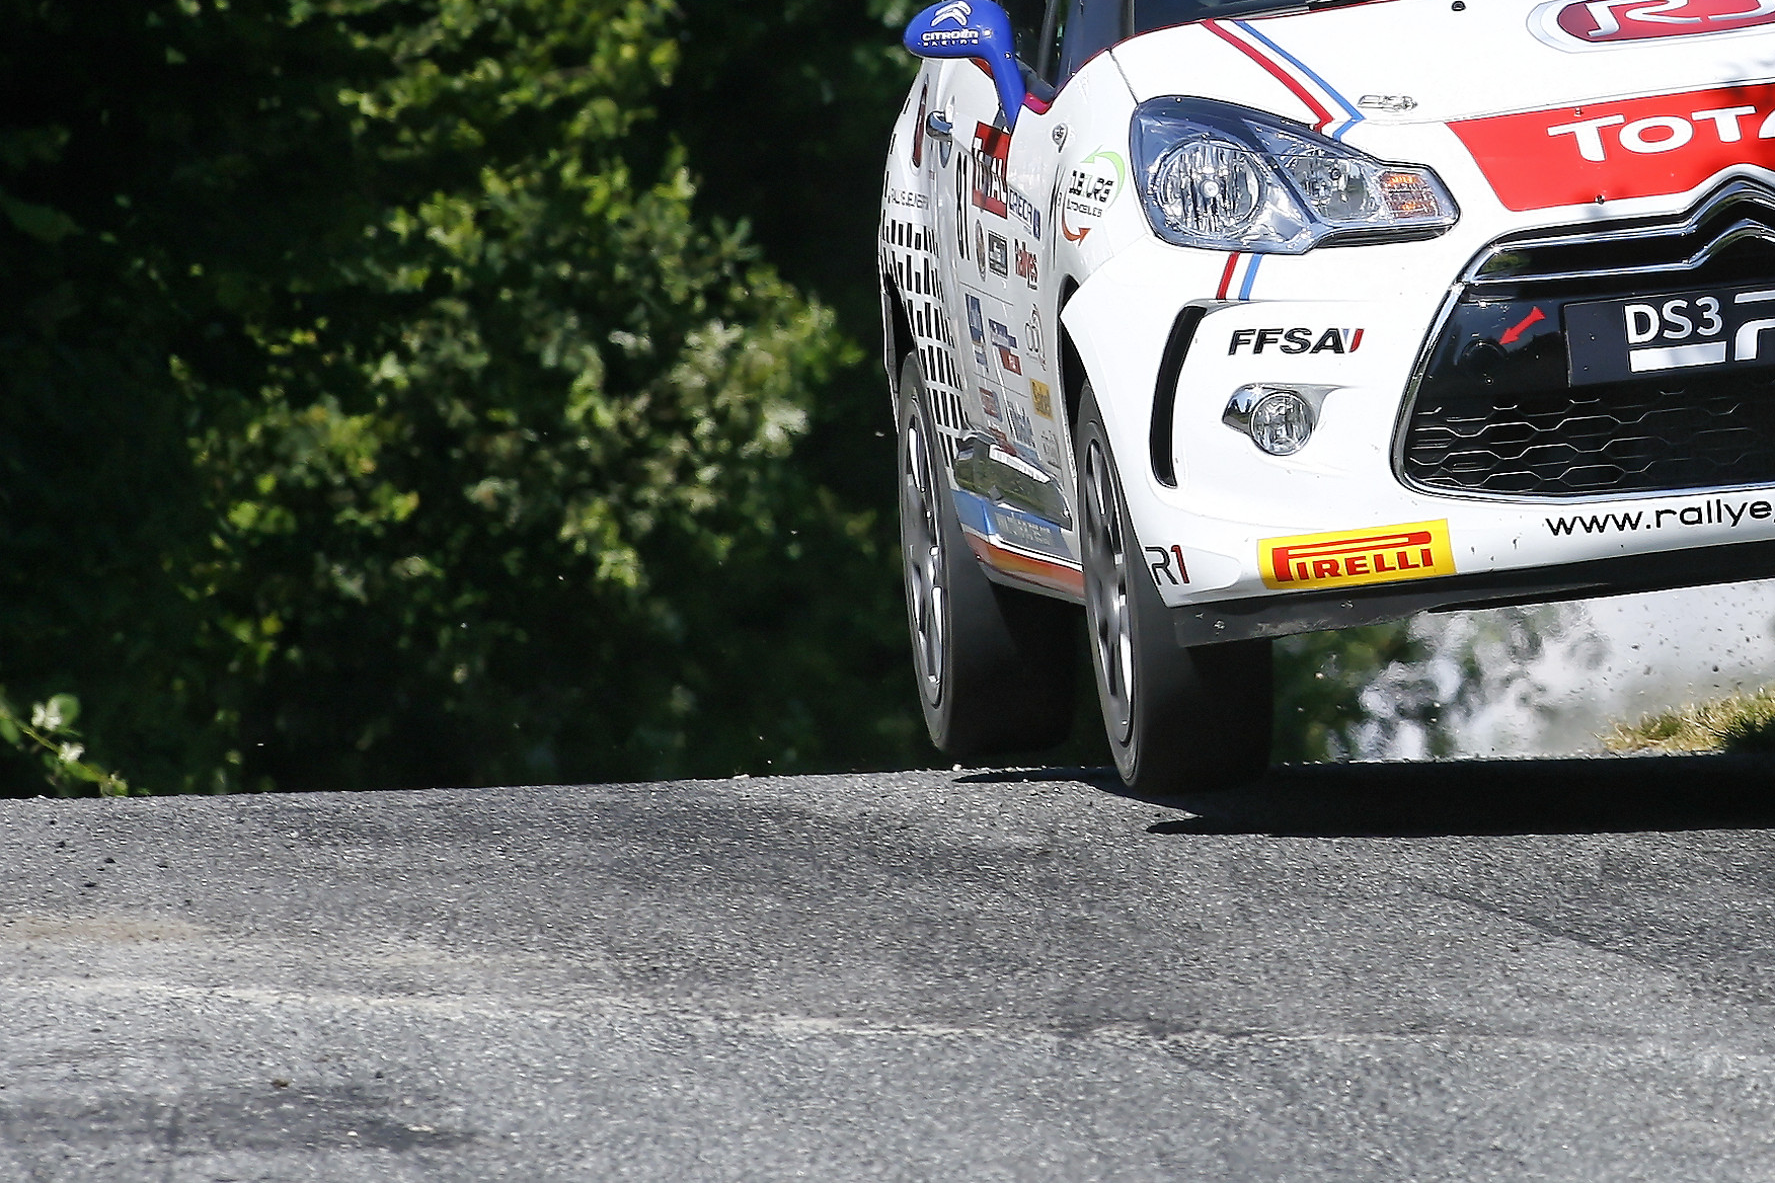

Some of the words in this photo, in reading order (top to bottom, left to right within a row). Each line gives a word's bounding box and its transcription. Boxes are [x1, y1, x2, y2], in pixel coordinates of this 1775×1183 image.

[956, 152, 971, 261] 81
[1227, 328, 1346, 356] FFSA
[1621, 296, 1724, 344] DS3
[1271, 530, 1434, 582] PIRELLI
